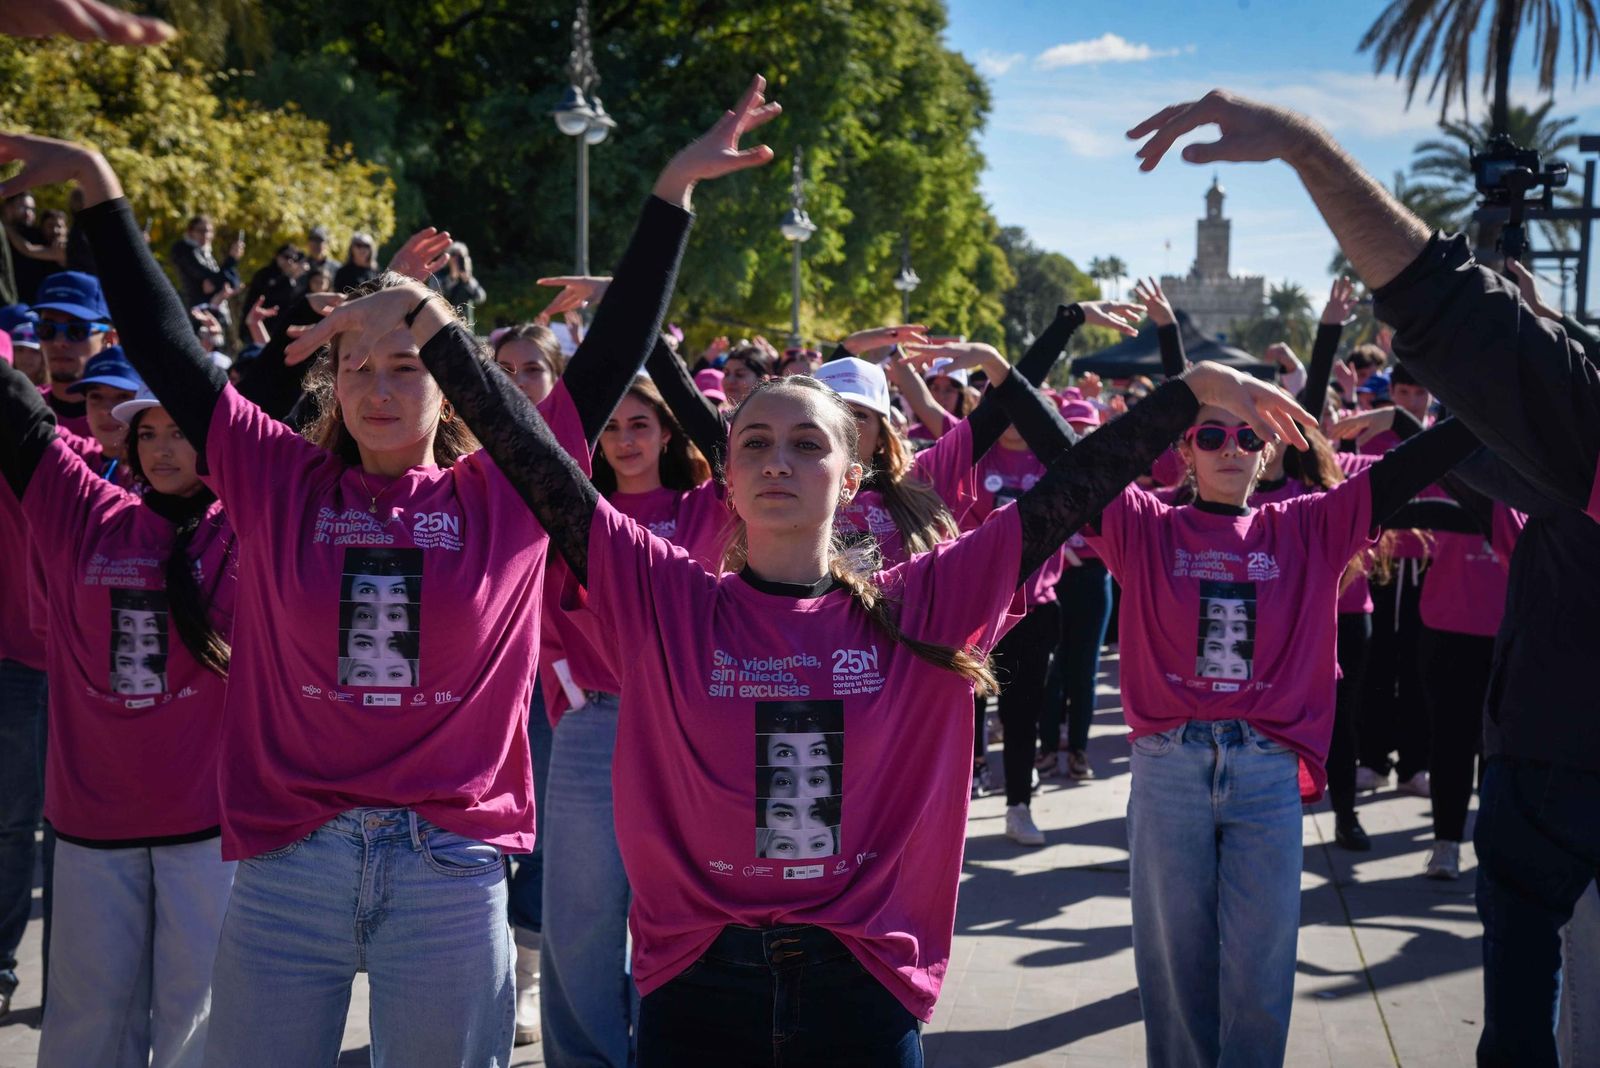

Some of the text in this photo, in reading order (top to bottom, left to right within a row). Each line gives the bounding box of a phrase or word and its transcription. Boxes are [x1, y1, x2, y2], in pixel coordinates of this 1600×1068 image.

[868, 505, 893, 523] 25N
[413, 512, 459, 535] 25N
[334, 531, 394, 546] excusas
[1175, 548, 1192, 560] Sin
[101, 577, 146, 587] excusas
[1190, 569, 1234, 581] excusas
[713, 650, 822, 671] Sin violencia,
[831, 645, 879, 674] 25N
[710, 665, 798, 685] sin miedo,
[434, 690, 452, 703] 016
[708, 681, 811, 698] sin excusas
